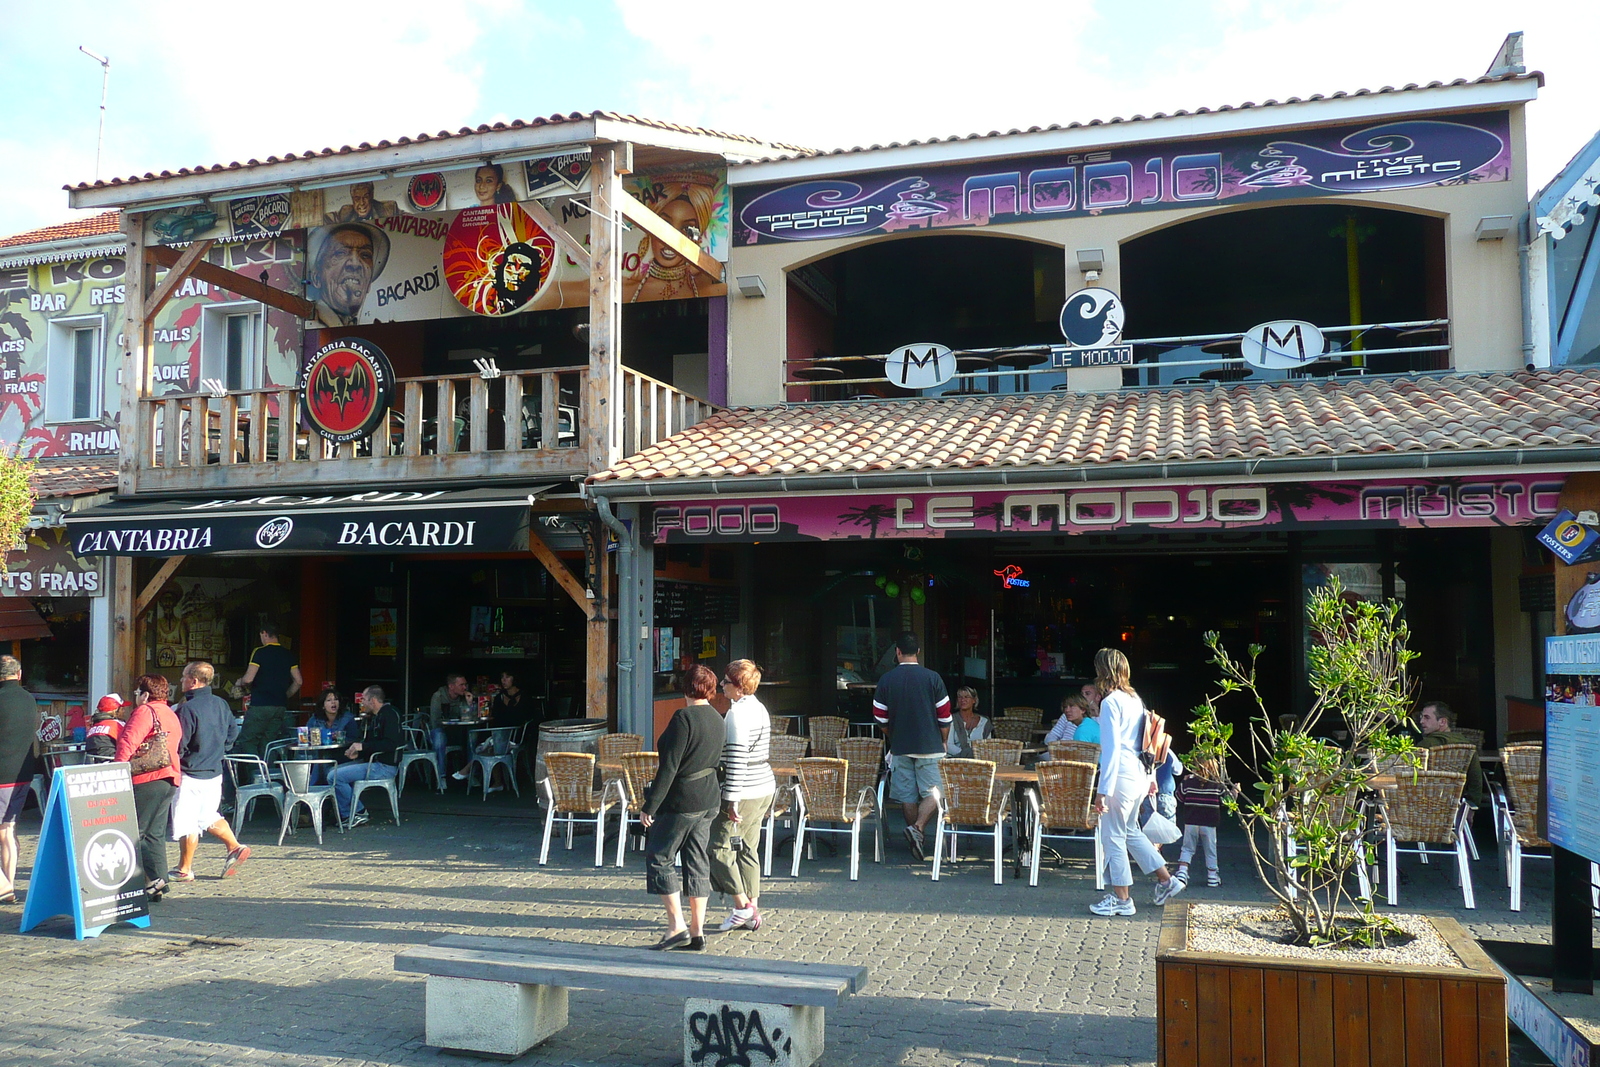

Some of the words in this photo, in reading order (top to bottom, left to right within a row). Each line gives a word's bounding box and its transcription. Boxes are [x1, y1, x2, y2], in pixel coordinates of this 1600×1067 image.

[1067, 151, 1112, 165] LE
[1356, 154, 1425, 169] LIVE
[1321, 160, 1462, 183] MUSIC
[963, 152, 1223, 220] MODJO
[234, 204, 256, 219] BACARDI
[259, 201, 289, 222] BACARDI
[771, 214, 868, 232] FOOD
[30, 293, 67, 312] BAR
[300, 340, 346, 389] CANTABRIA
[350, 341, 384, 383] BACARDI
[1052, 351, 1073, 369] LE
[1081, 348, 1131, 367] MODJO
[3, 369, 17, 381] DE
[5, 381, 39, 394] FRAIS
[337, 429, 363, 441] CUBANO
[895, 496, 975, 529] LE
[1003, 486, 1268, 527] MODJO
[1359, 480, 1565, 519] MUSIC
[652, 504, 780, 536] FOOD
[78, 526, 213, 554] CANTABRIA
[337, 520, 477, 547] BACARDI
[1541, 533, 1574, 560] FOSTER'S
[40, 570, 99, 592] FRAIS
[66, 768, 130, 785] CANTABRIA
[69, 778, 131, 799] BACARDI
